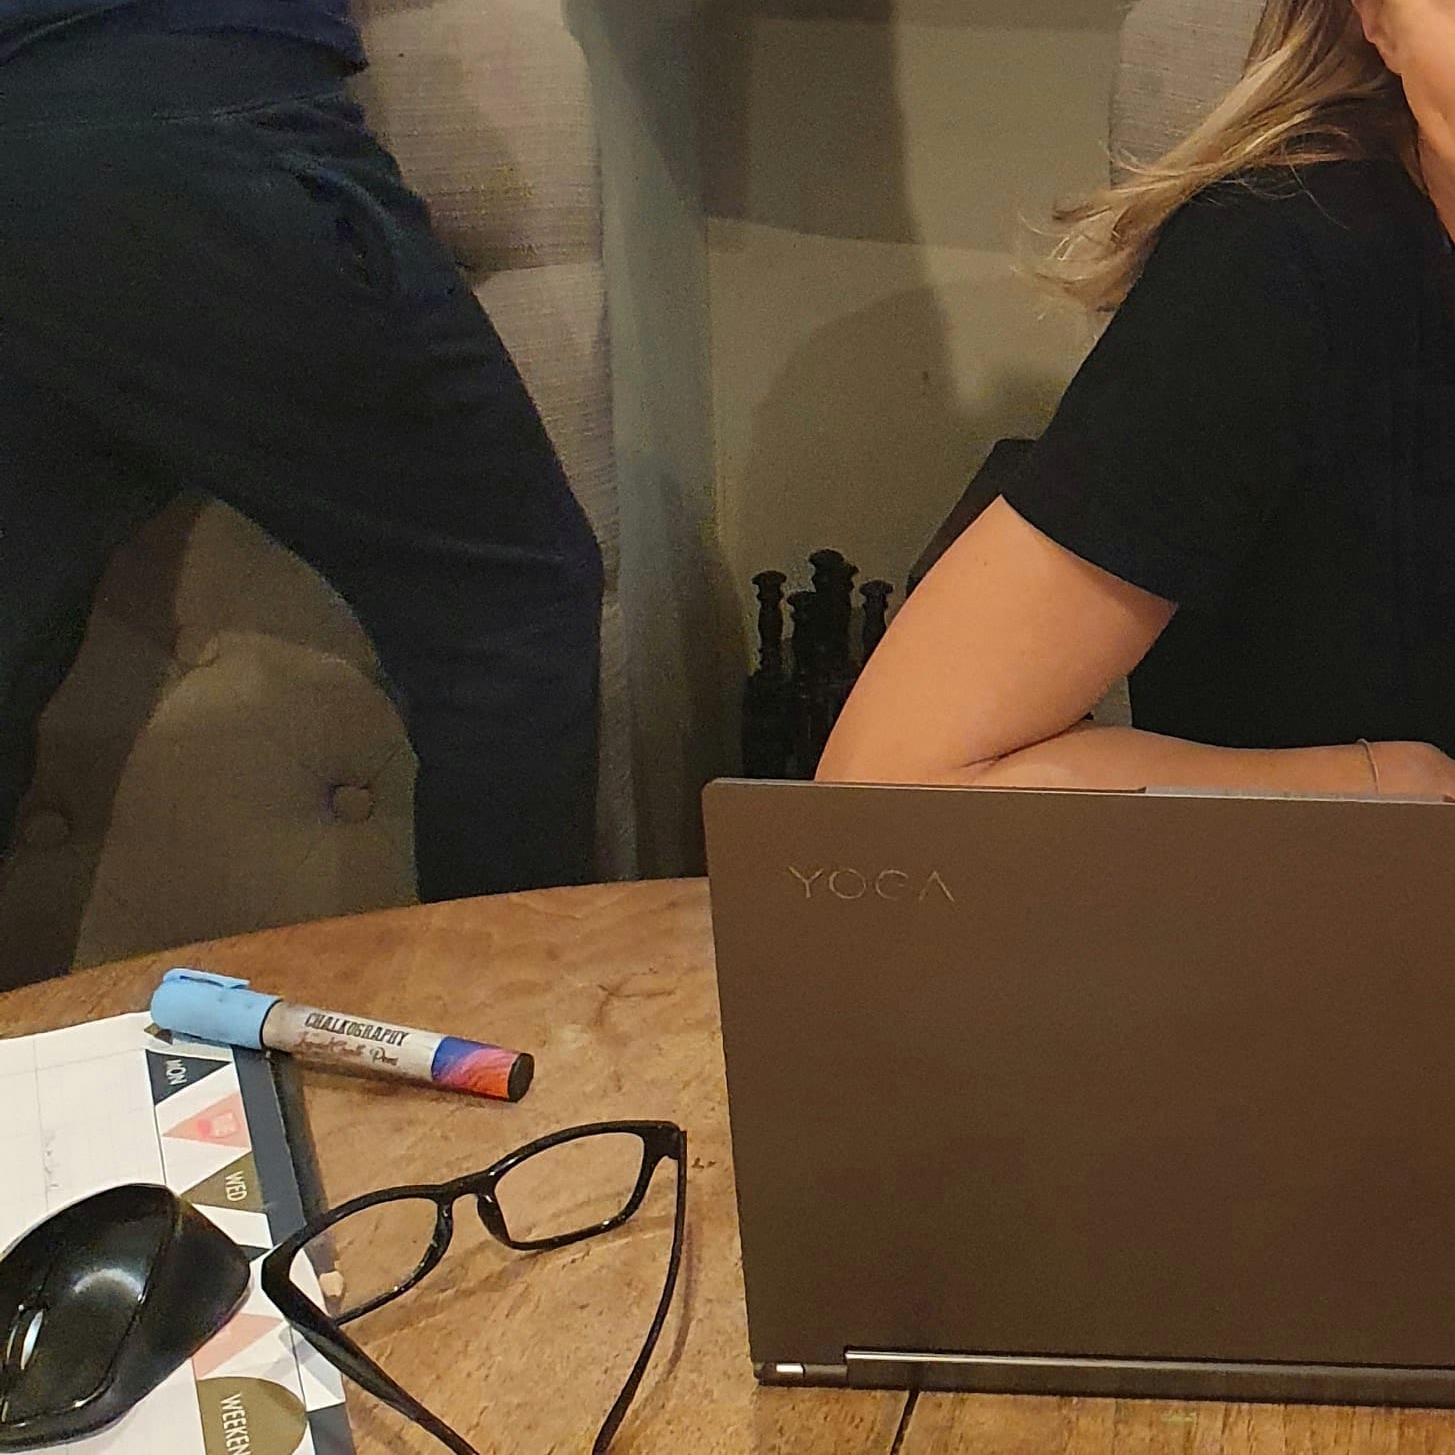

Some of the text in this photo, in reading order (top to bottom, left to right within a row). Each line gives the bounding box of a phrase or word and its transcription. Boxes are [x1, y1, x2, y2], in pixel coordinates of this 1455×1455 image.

[787, 865, 955, 902] YOGA
[304, 1011, 410, 1047] CHALKOGRAPHY
[165, 1058, 188, 1086] MON
[224, 1170, 248, 1202] WED
